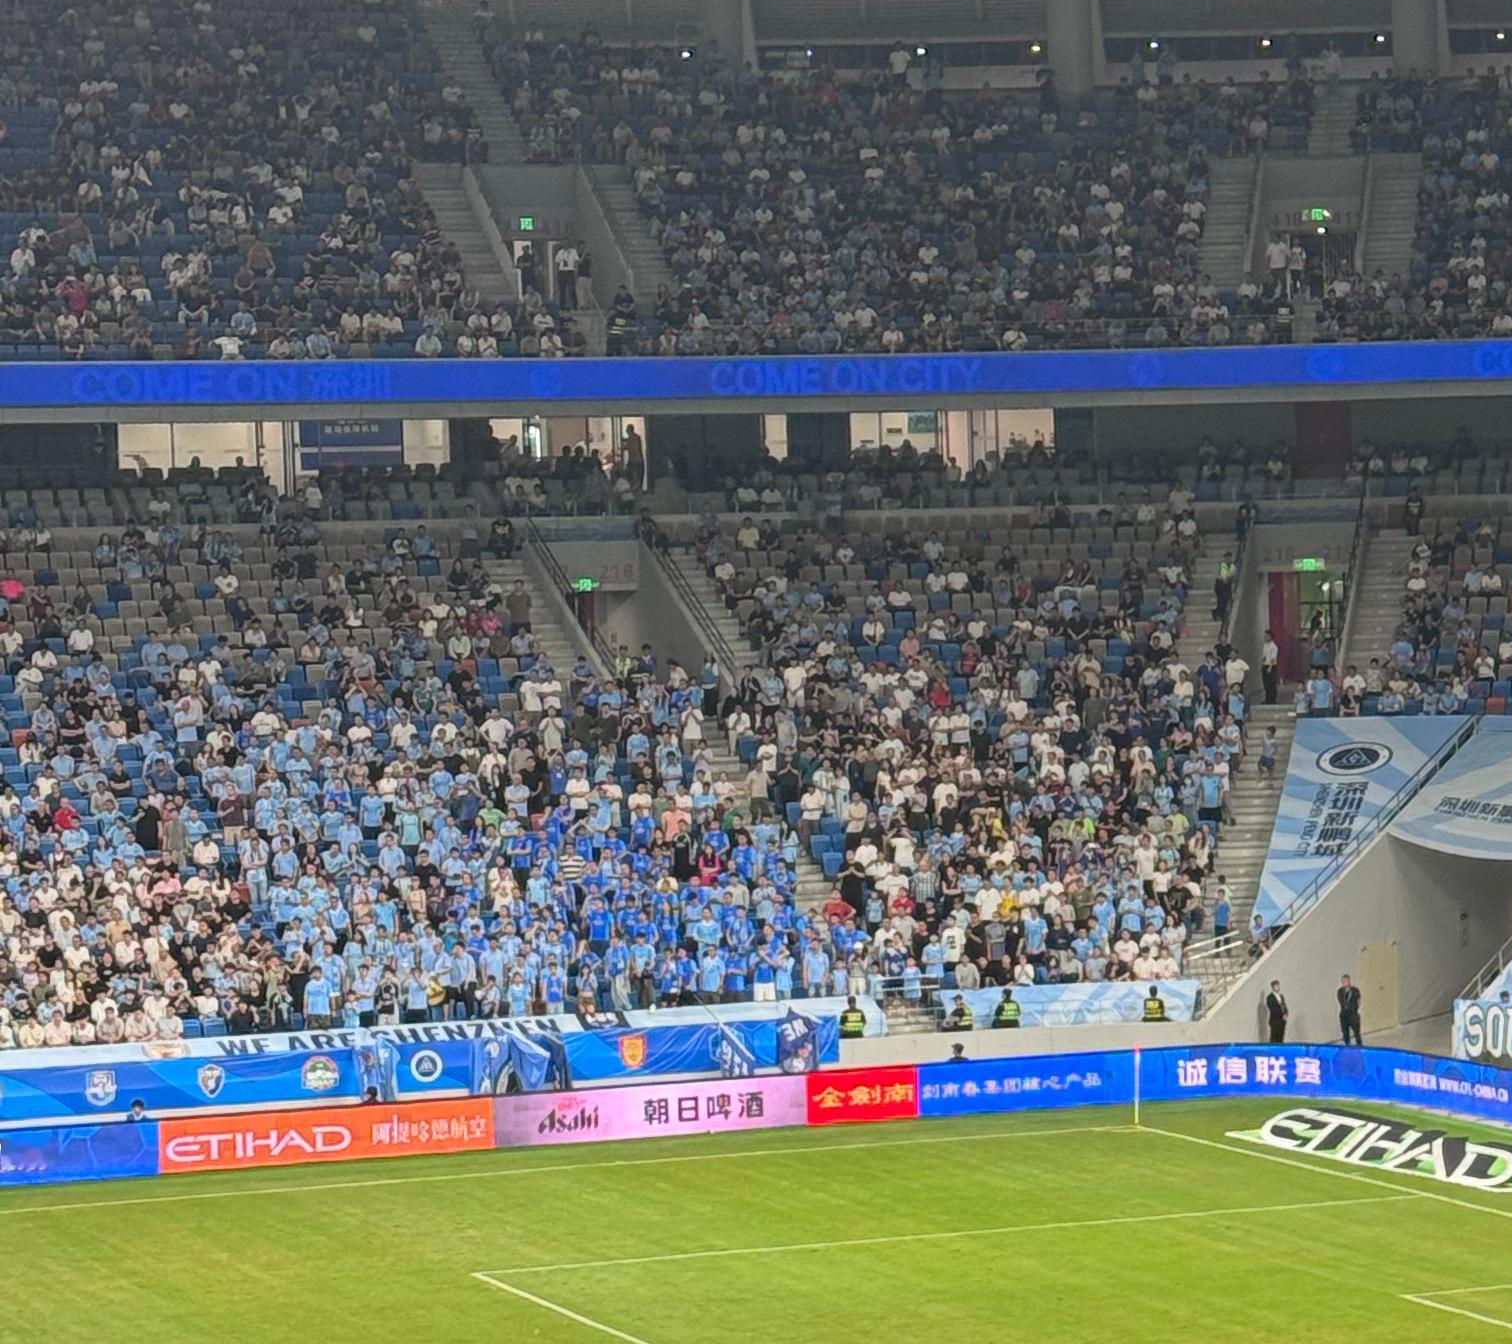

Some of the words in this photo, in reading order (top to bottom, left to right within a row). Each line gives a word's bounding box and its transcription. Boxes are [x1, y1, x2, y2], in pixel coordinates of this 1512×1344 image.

[72, 365, 214, 402] COME
[227, 363, 298, 400] ON
[711, 362, 821, 395] COME
[834, 360, 891, 393] ON
[903, 359, 983, 392] CITY
[216, 1036, 270, 1057] WE
[288, 1031, 356, 1052] ARE
[1176, 1056, 1322, 1087] 诚信联赛
[537, 1105, 599, 1135] Asahi
[643, 1090, 764, 1126] 朝日啤酒
[166, 1125, 353, 1162] ETIHAD
[371, 1113, 487, 1145] 阿提哈德航空
